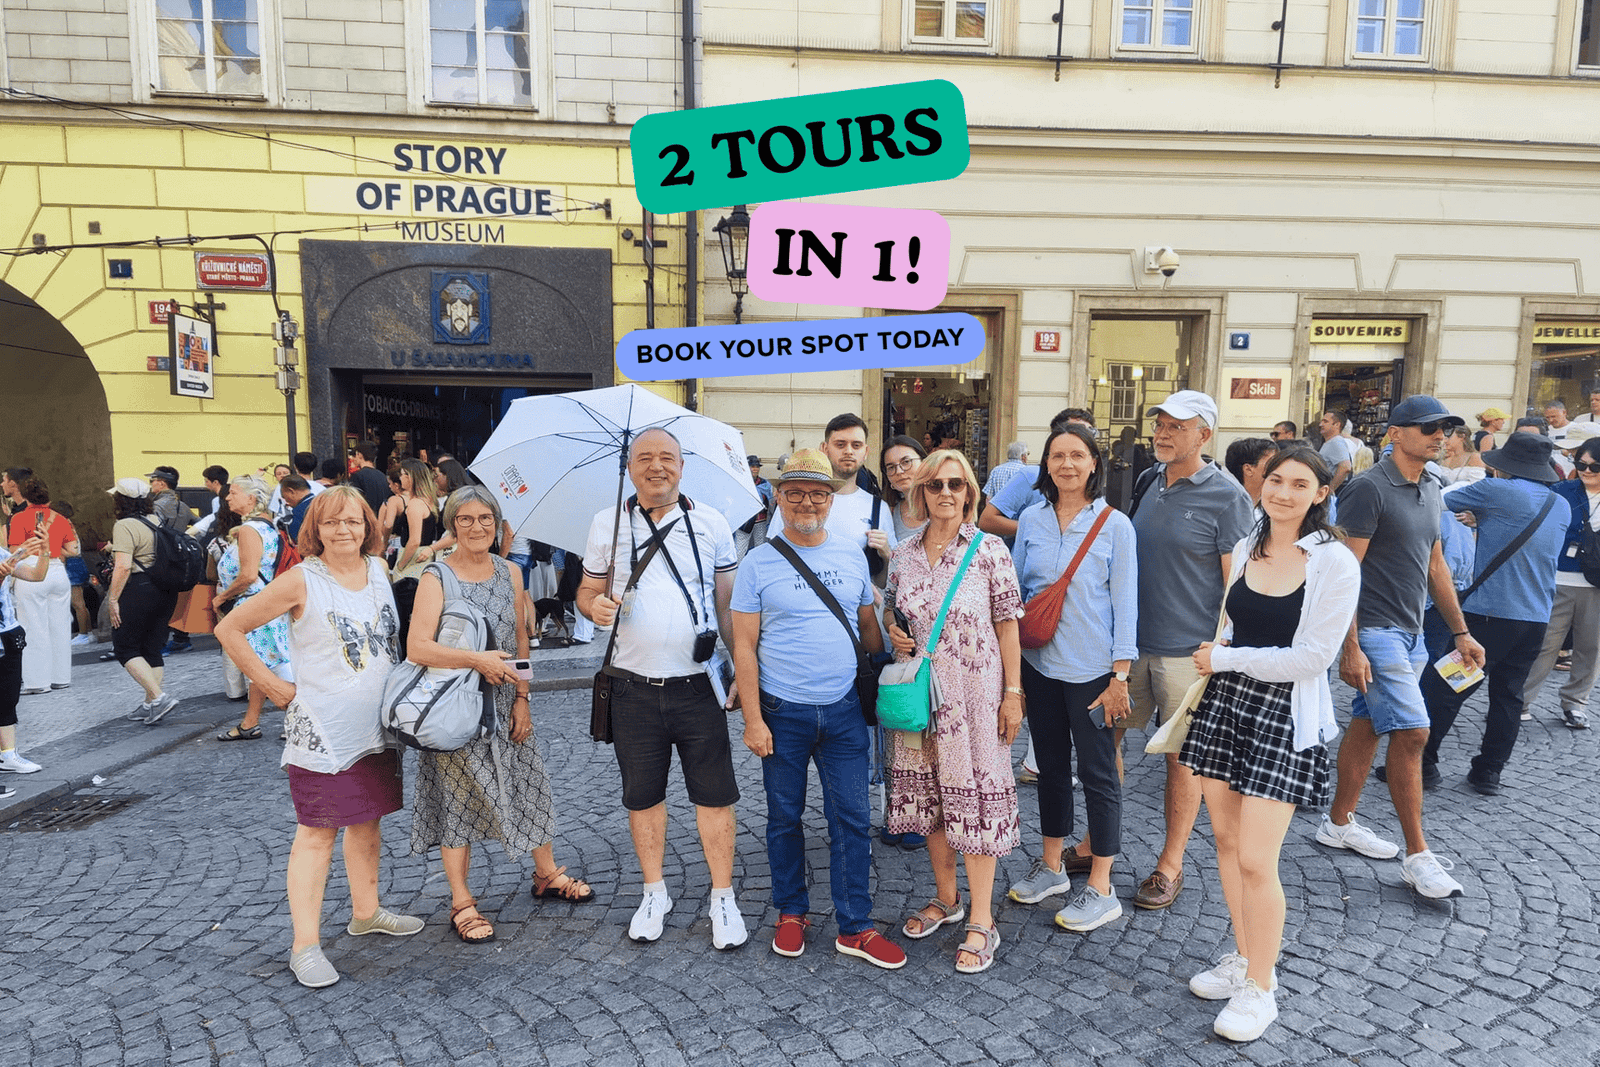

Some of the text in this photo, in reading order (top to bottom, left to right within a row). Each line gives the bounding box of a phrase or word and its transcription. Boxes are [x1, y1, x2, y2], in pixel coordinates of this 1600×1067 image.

[394, 143, 507, 175] STORY
[356, 182, 552, 216] OF PRAGUE
[402, 221, 505, 243] MUSEUM
[117, 263, 122, 274] 1
[155, 303, 171, 314] 194
[1314, 326, 1402, 336] SOUVENIRS
[1040, 333, 1055, 343] 193
[1237, 336, 1244, 346] 2
[1249, 383, 1276, 395] Skils
[795, 570, 838, 581] TMMY
